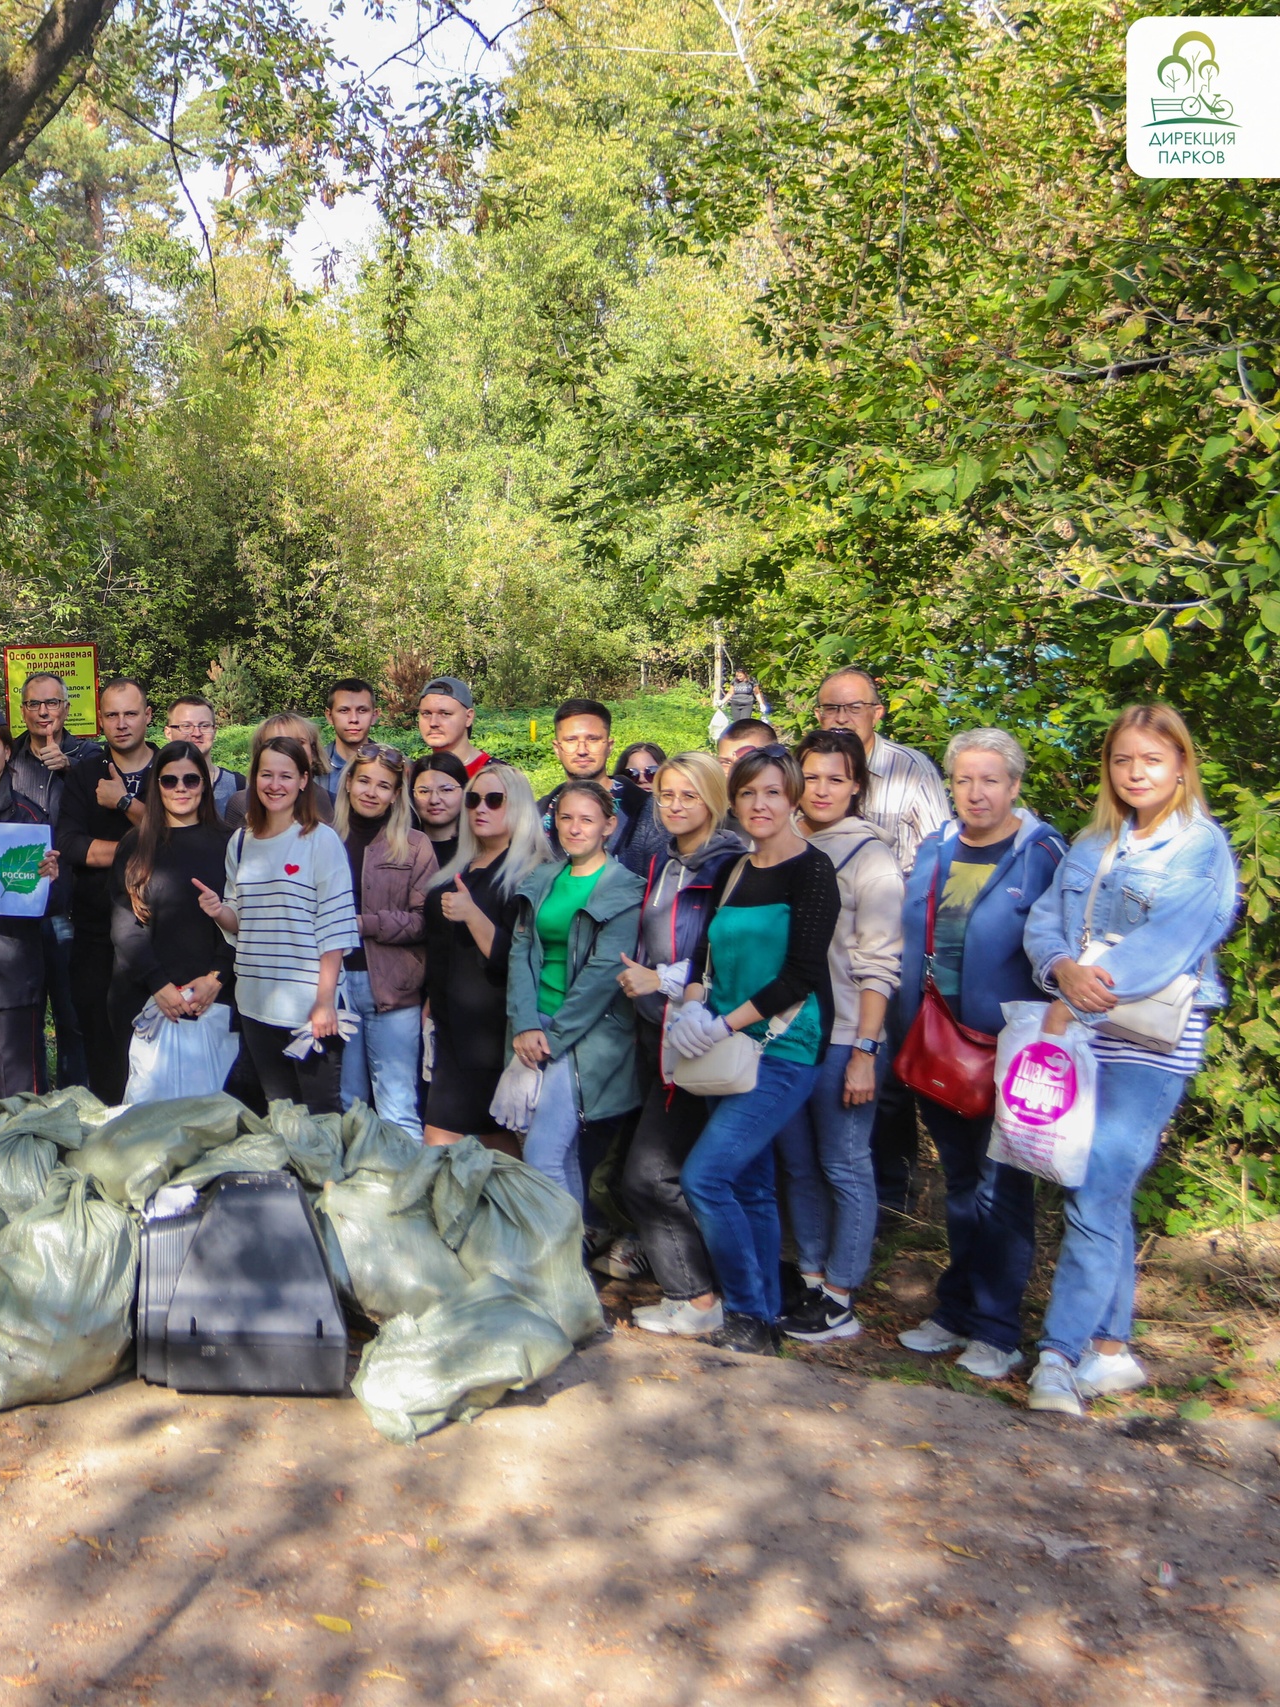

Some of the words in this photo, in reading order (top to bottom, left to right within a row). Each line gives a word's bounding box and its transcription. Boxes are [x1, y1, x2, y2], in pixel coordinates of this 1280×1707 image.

[9, 651, 36, 660] Особо
[39, 651, 92, 660] охраняемая
[27, 661, 75, 670] природная
[2, 871, 36, 880] РОССИЯ
